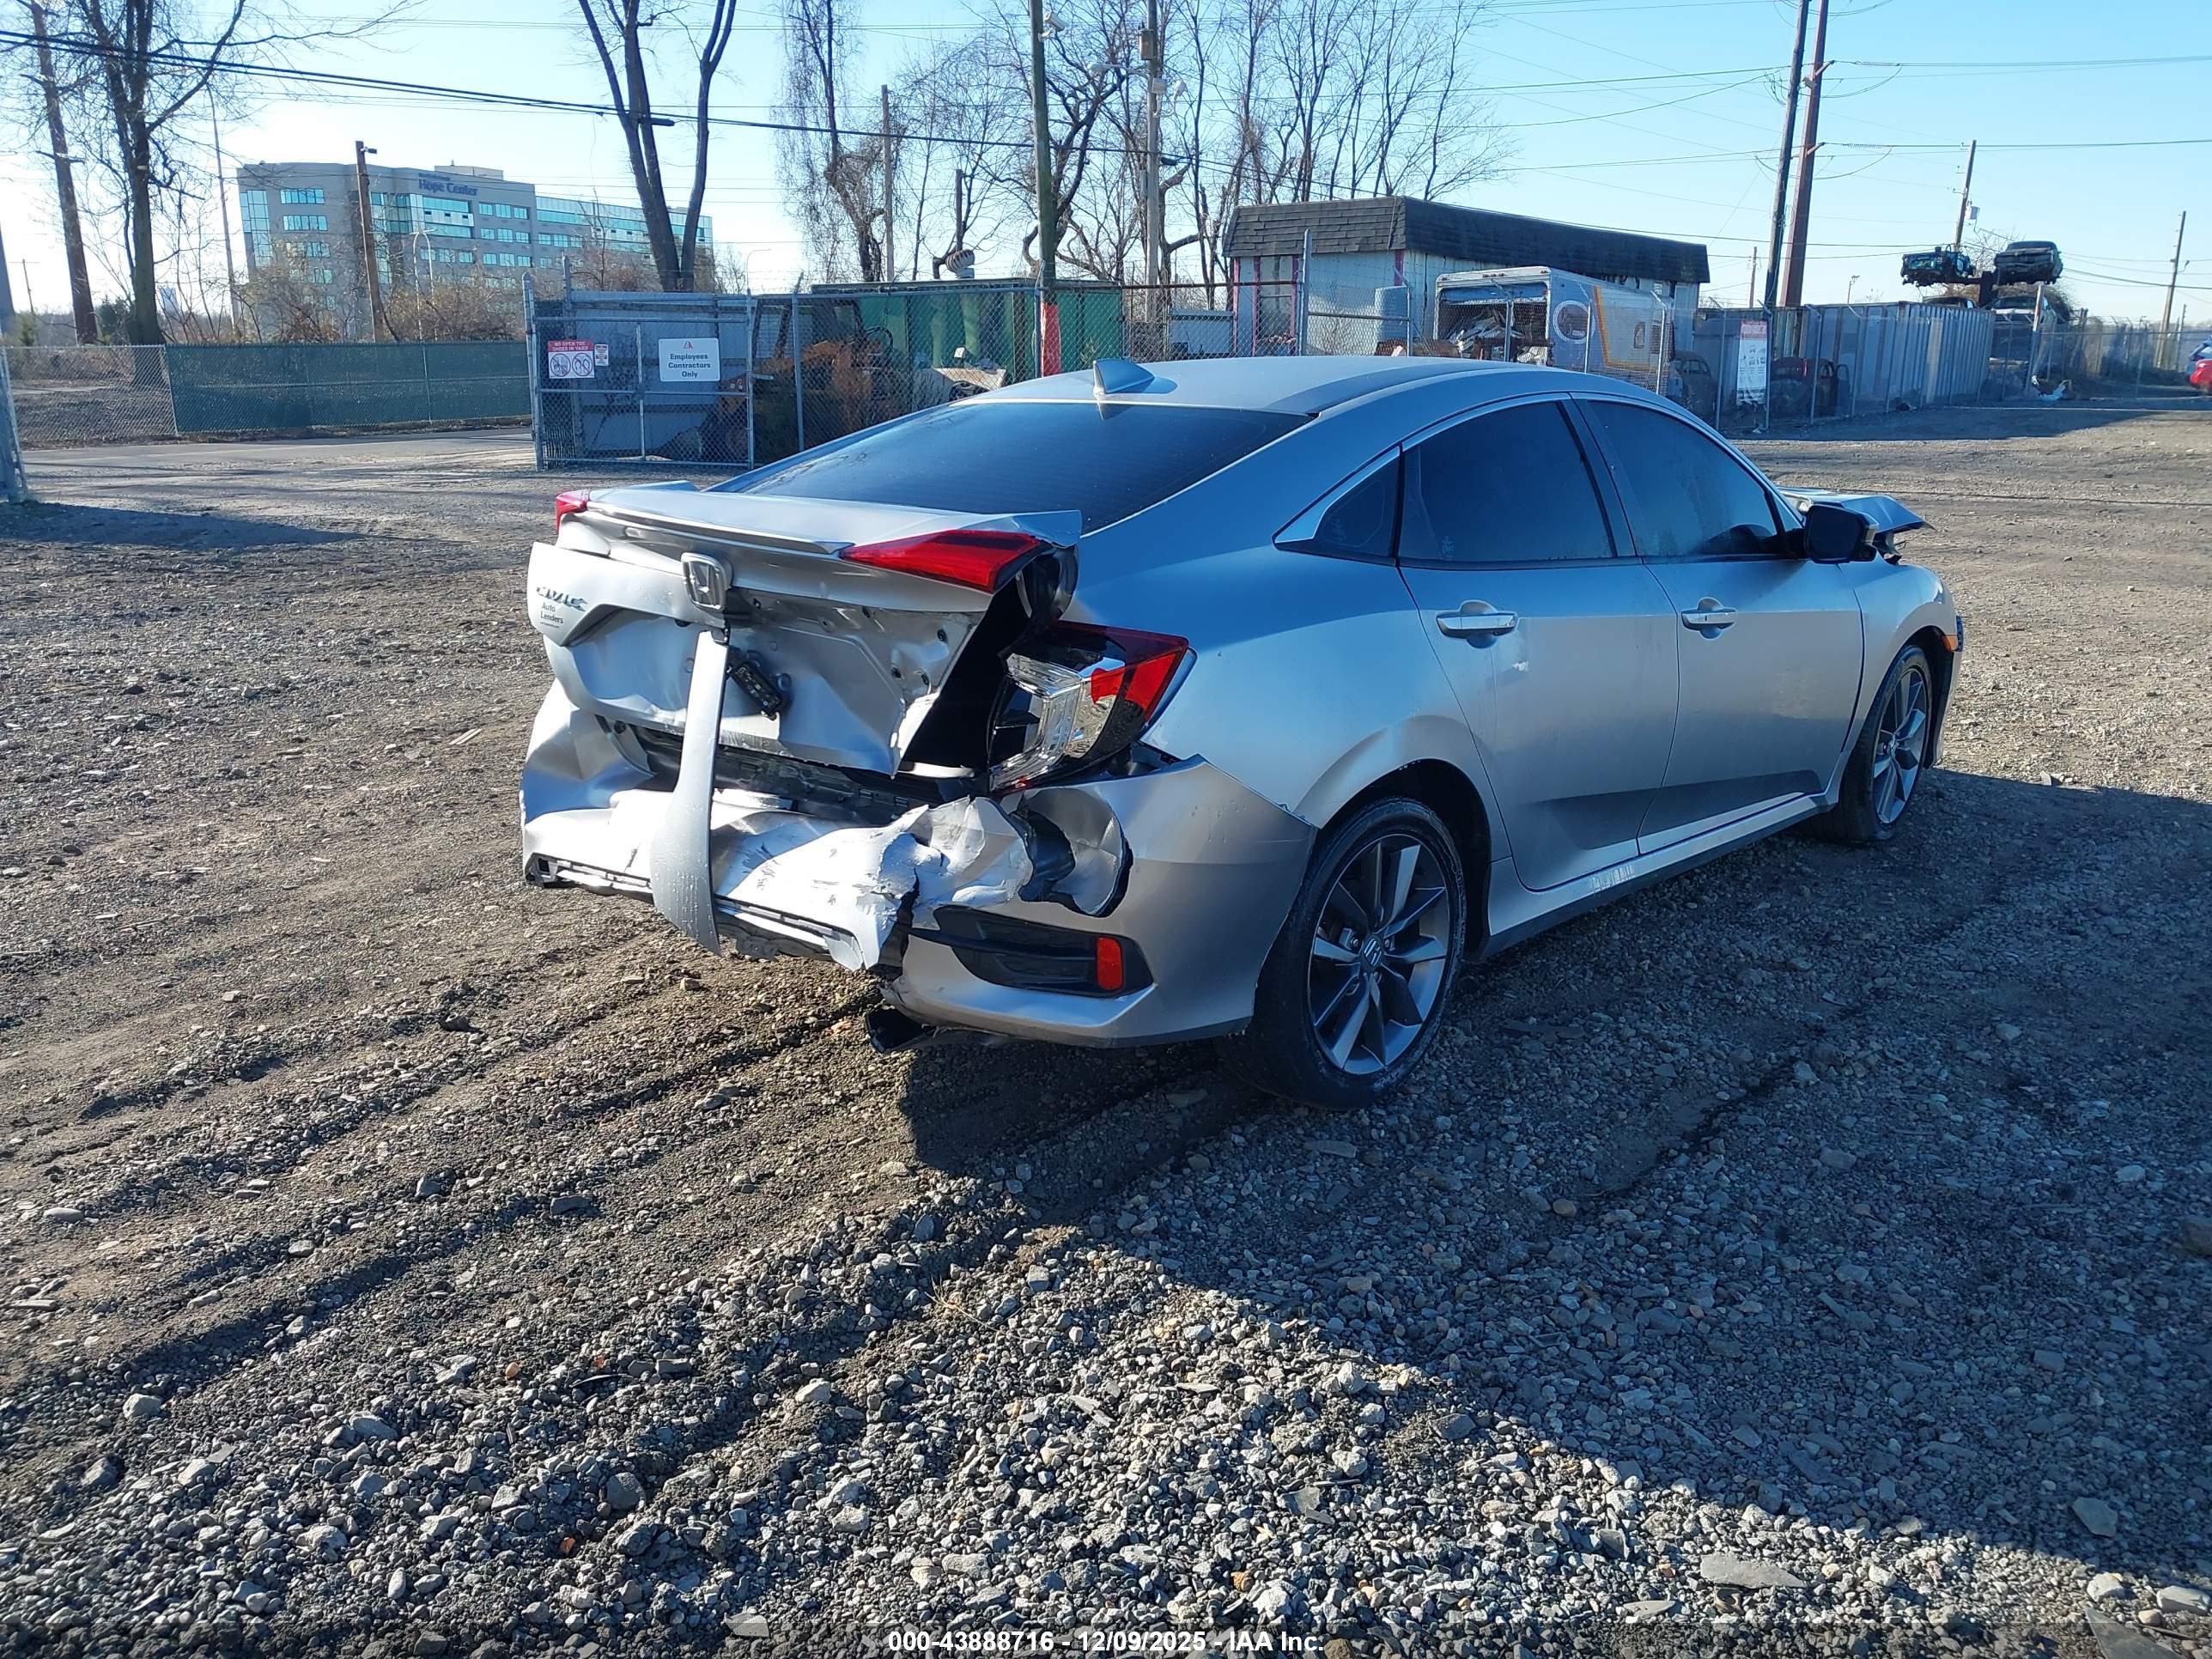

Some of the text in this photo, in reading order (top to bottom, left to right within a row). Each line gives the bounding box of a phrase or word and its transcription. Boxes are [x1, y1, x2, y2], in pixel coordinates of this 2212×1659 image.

[418, 179, 478, 197] Hope Center
[541, 601, 556, 612] Auto
[540, 611, 564, 624] Lenders
